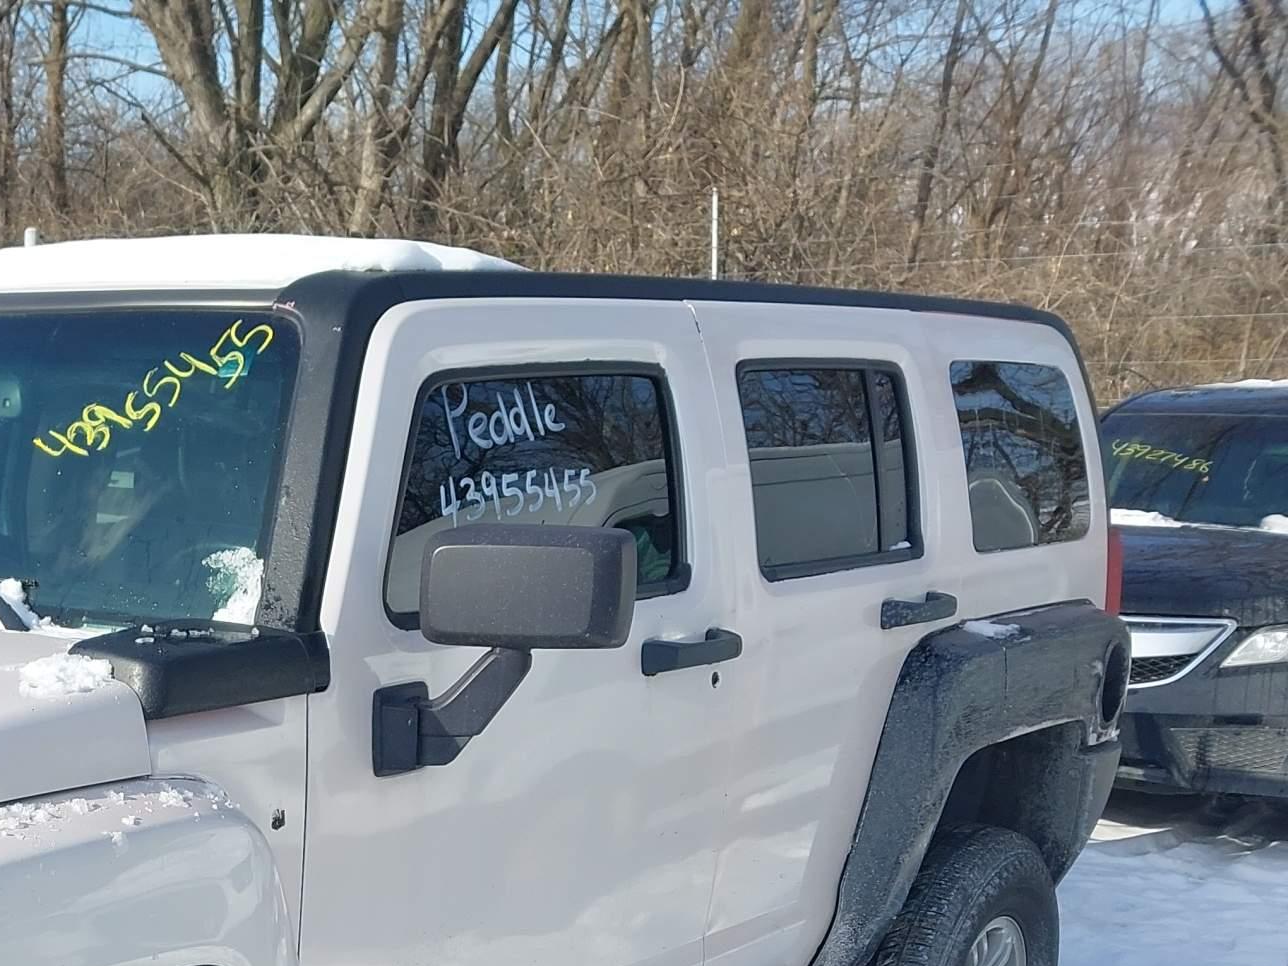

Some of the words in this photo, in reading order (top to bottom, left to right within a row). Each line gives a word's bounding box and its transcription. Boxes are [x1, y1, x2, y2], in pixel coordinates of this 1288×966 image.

[32, 318, 274, 457] 43955455
[442, 382, 567, 460] Peddle
[1111, 438, 1214, 473] 43927486
[439, 466, 599, 528] 43955455
